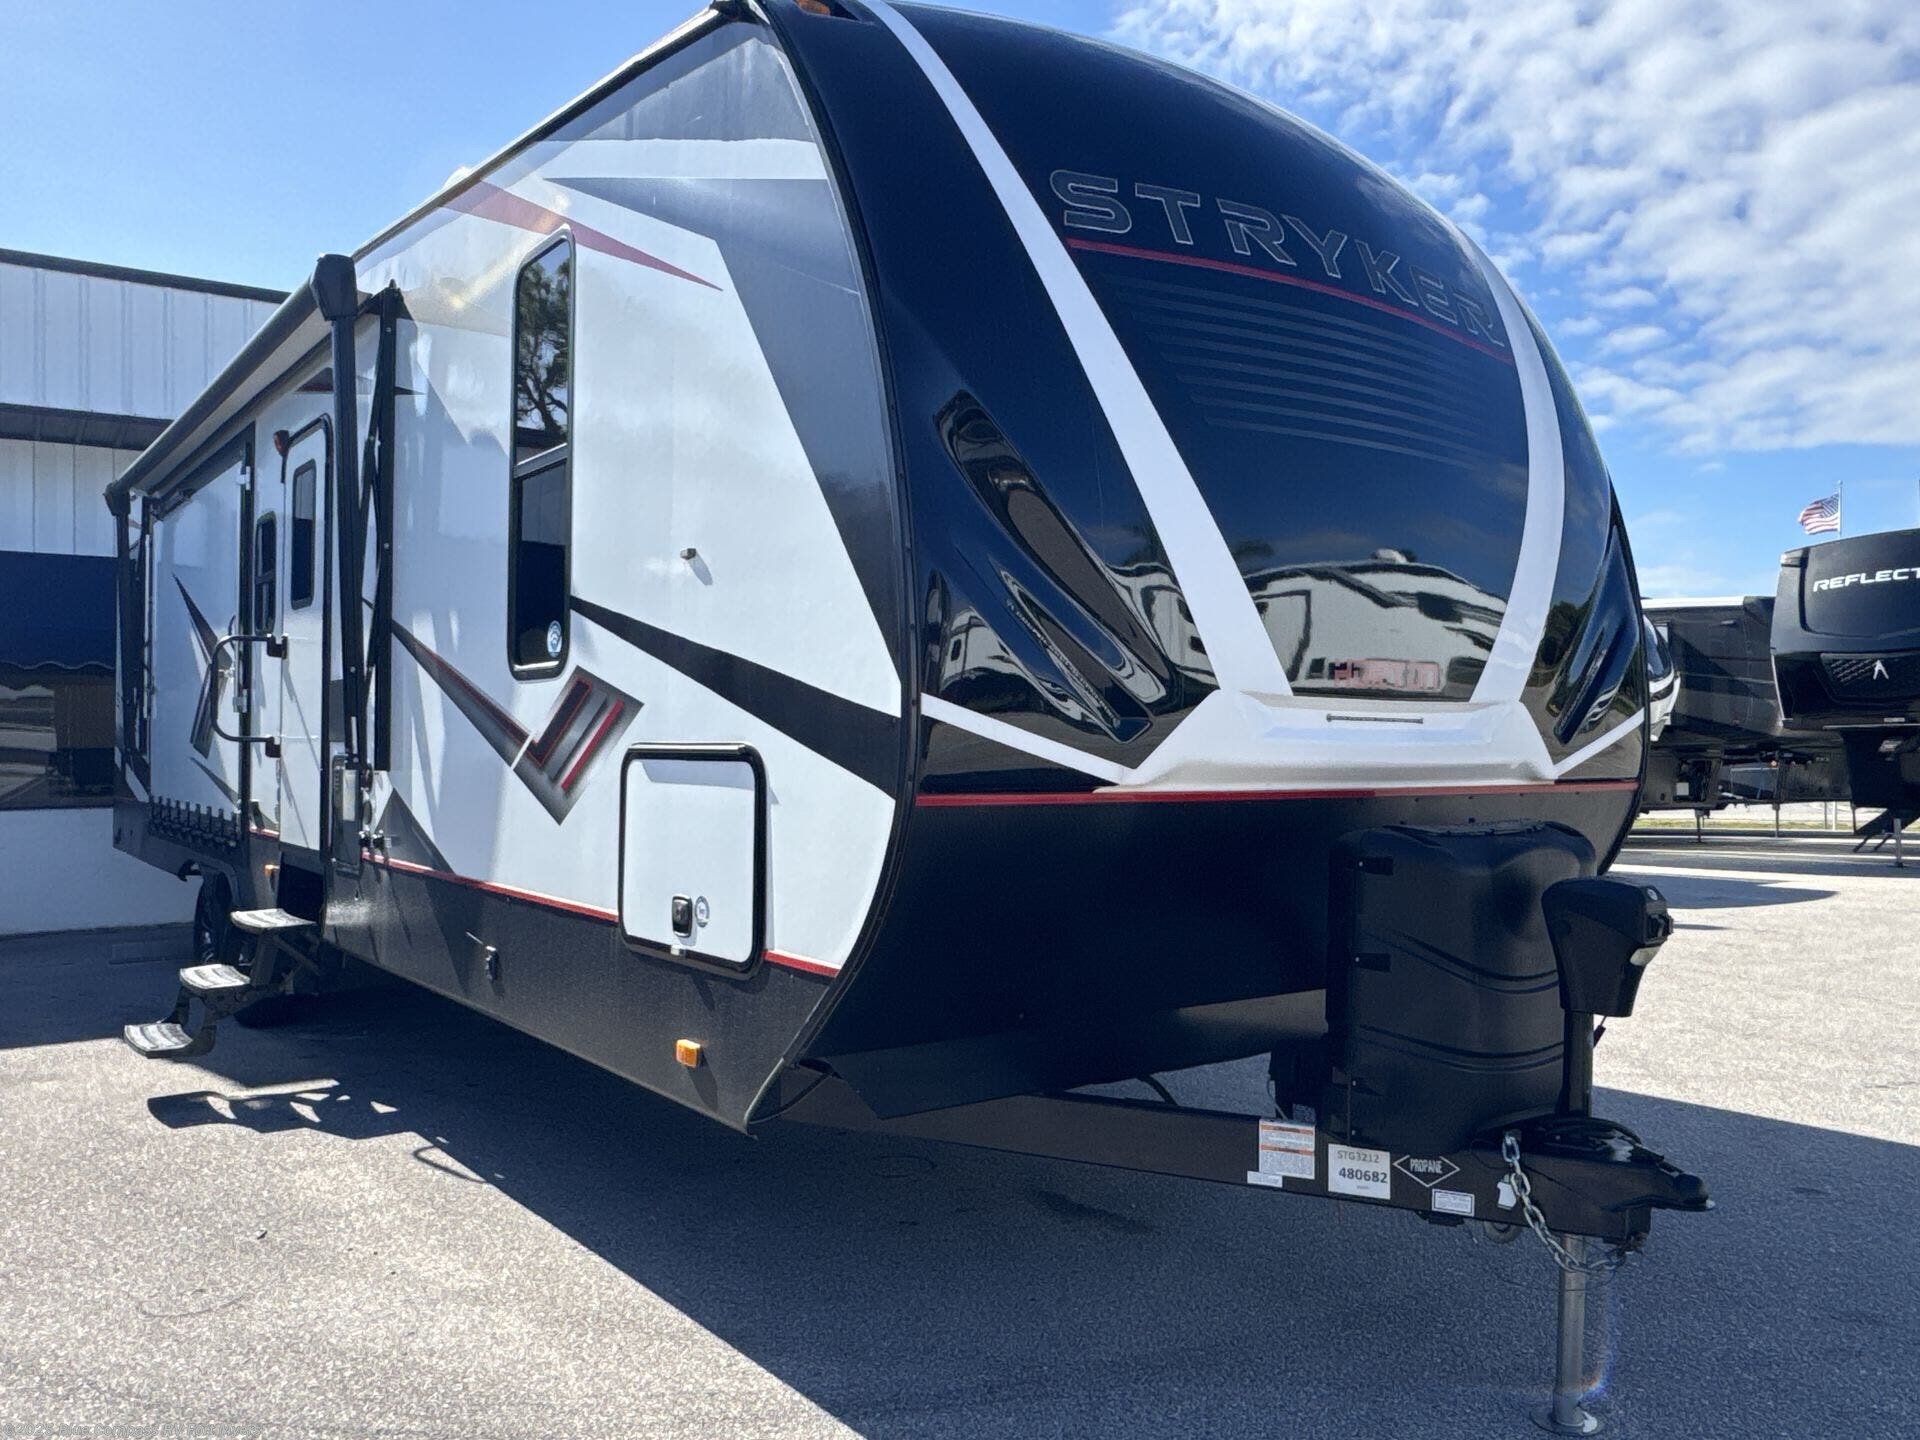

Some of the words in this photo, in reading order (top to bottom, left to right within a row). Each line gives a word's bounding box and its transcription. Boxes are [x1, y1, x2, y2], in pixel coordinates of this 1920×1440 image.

[1049, 169, 1505, 347] STRYKER
[1337, 1150, 1380, 1163] STG3212
[1409, 1158, 1442, 1174] PROPANE
[1339, 1167, 1388, 1184] 480682
